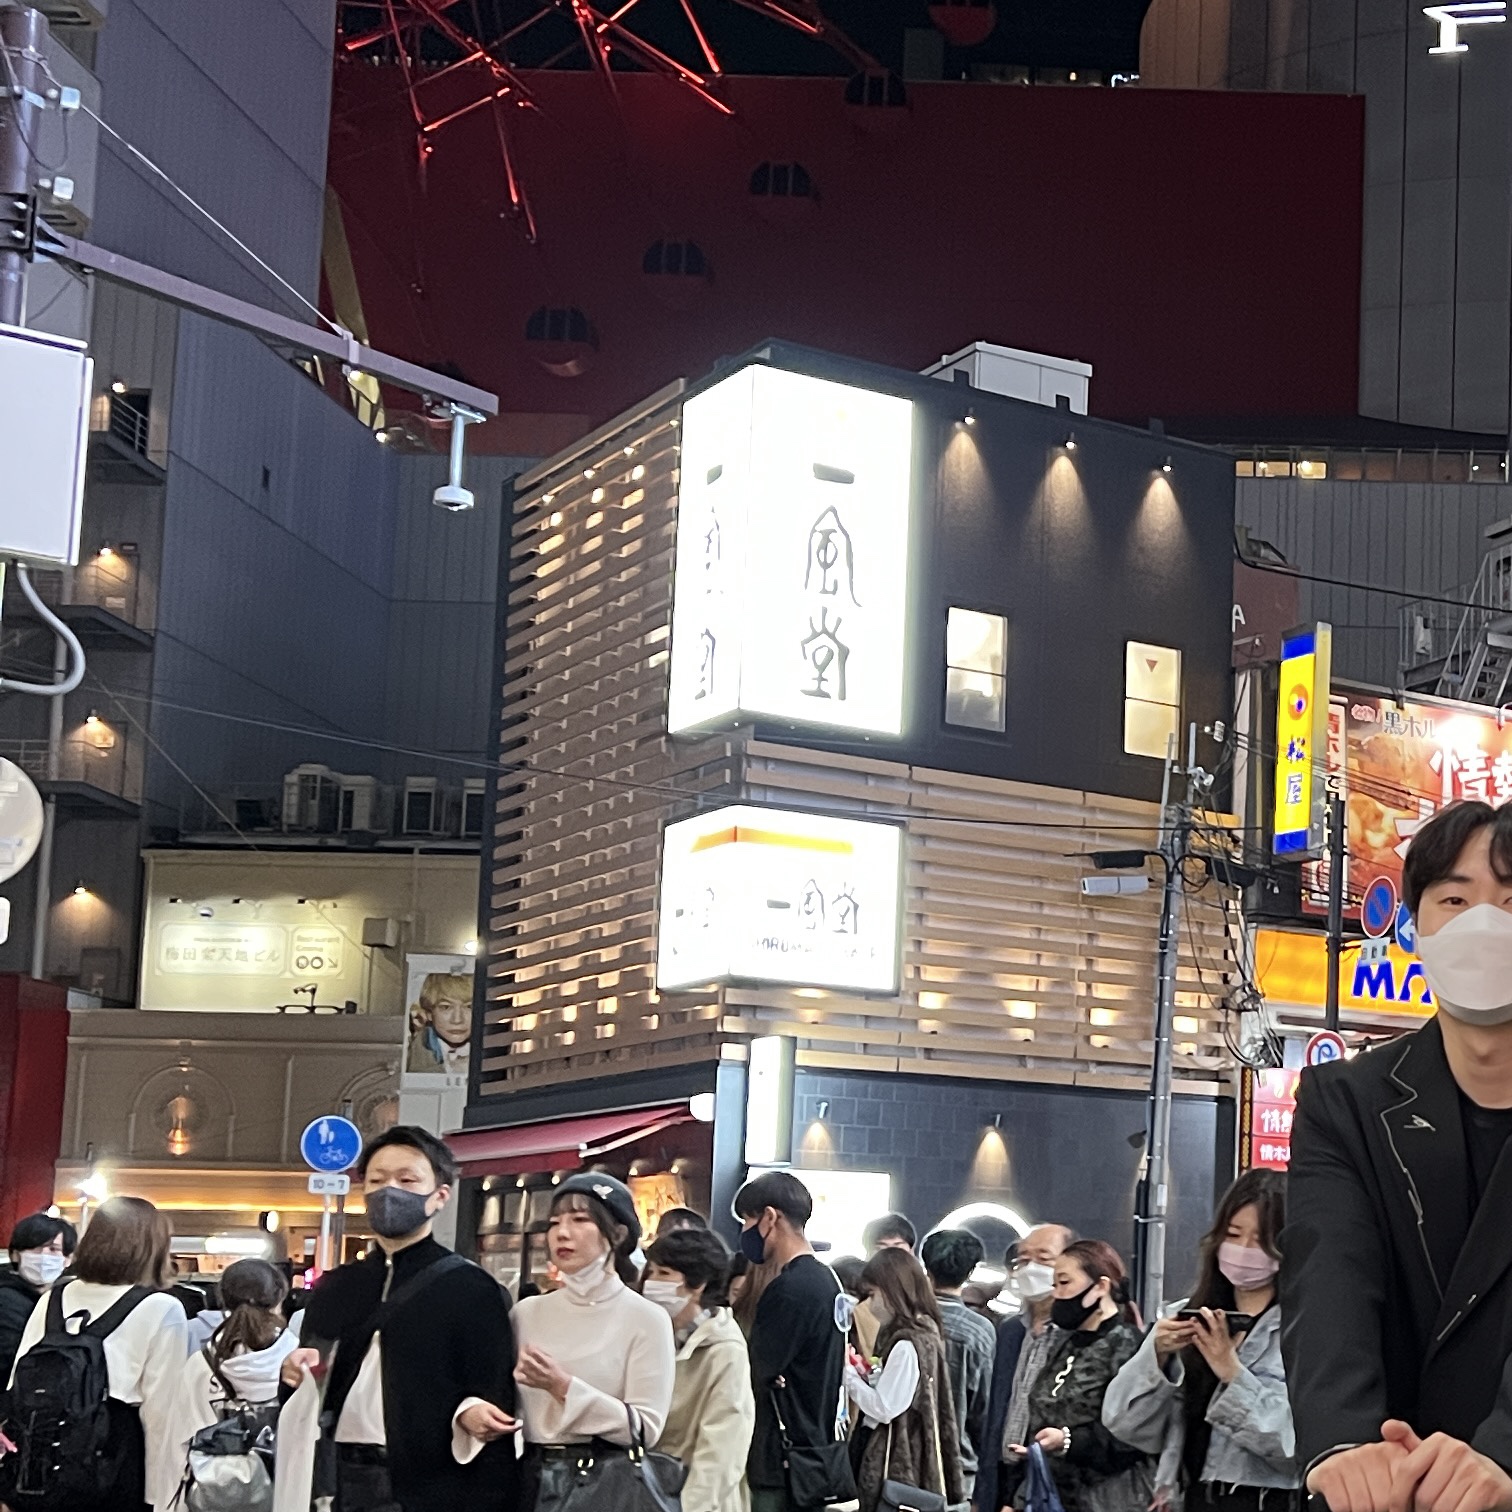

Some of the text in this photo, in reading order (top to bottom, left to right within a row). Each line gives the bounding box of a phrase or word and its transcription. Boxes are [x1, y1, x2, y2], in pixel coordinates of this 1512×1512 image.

[800, 461, 863, 702] 一風堂
[1285, 733, 1306, 805] 松屋
